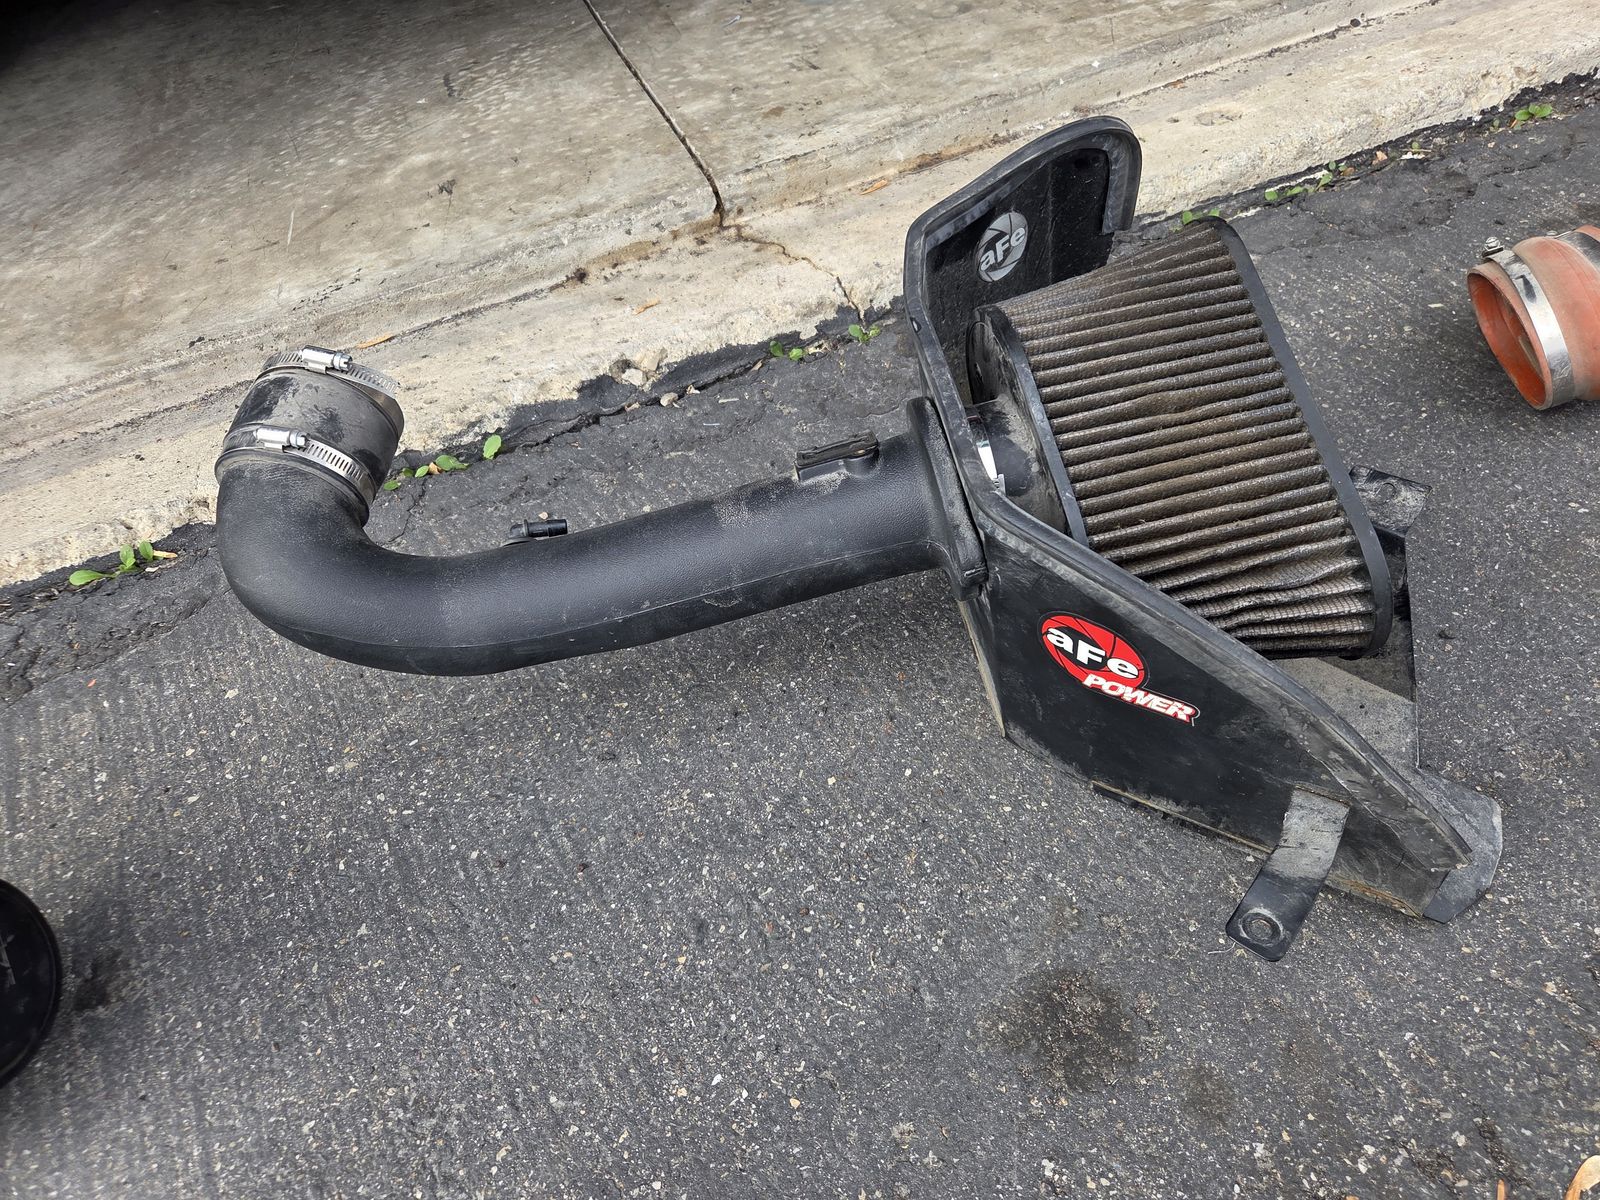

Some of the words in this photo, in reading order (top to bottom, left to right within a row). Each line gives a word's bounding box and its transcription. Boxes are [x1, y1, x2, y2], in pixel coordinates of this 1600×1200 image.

[980, 227, 1026, 271] aFe
[1046, 627, 1139, 680] aFe
[1082, 673, 1196, 722] POWER
